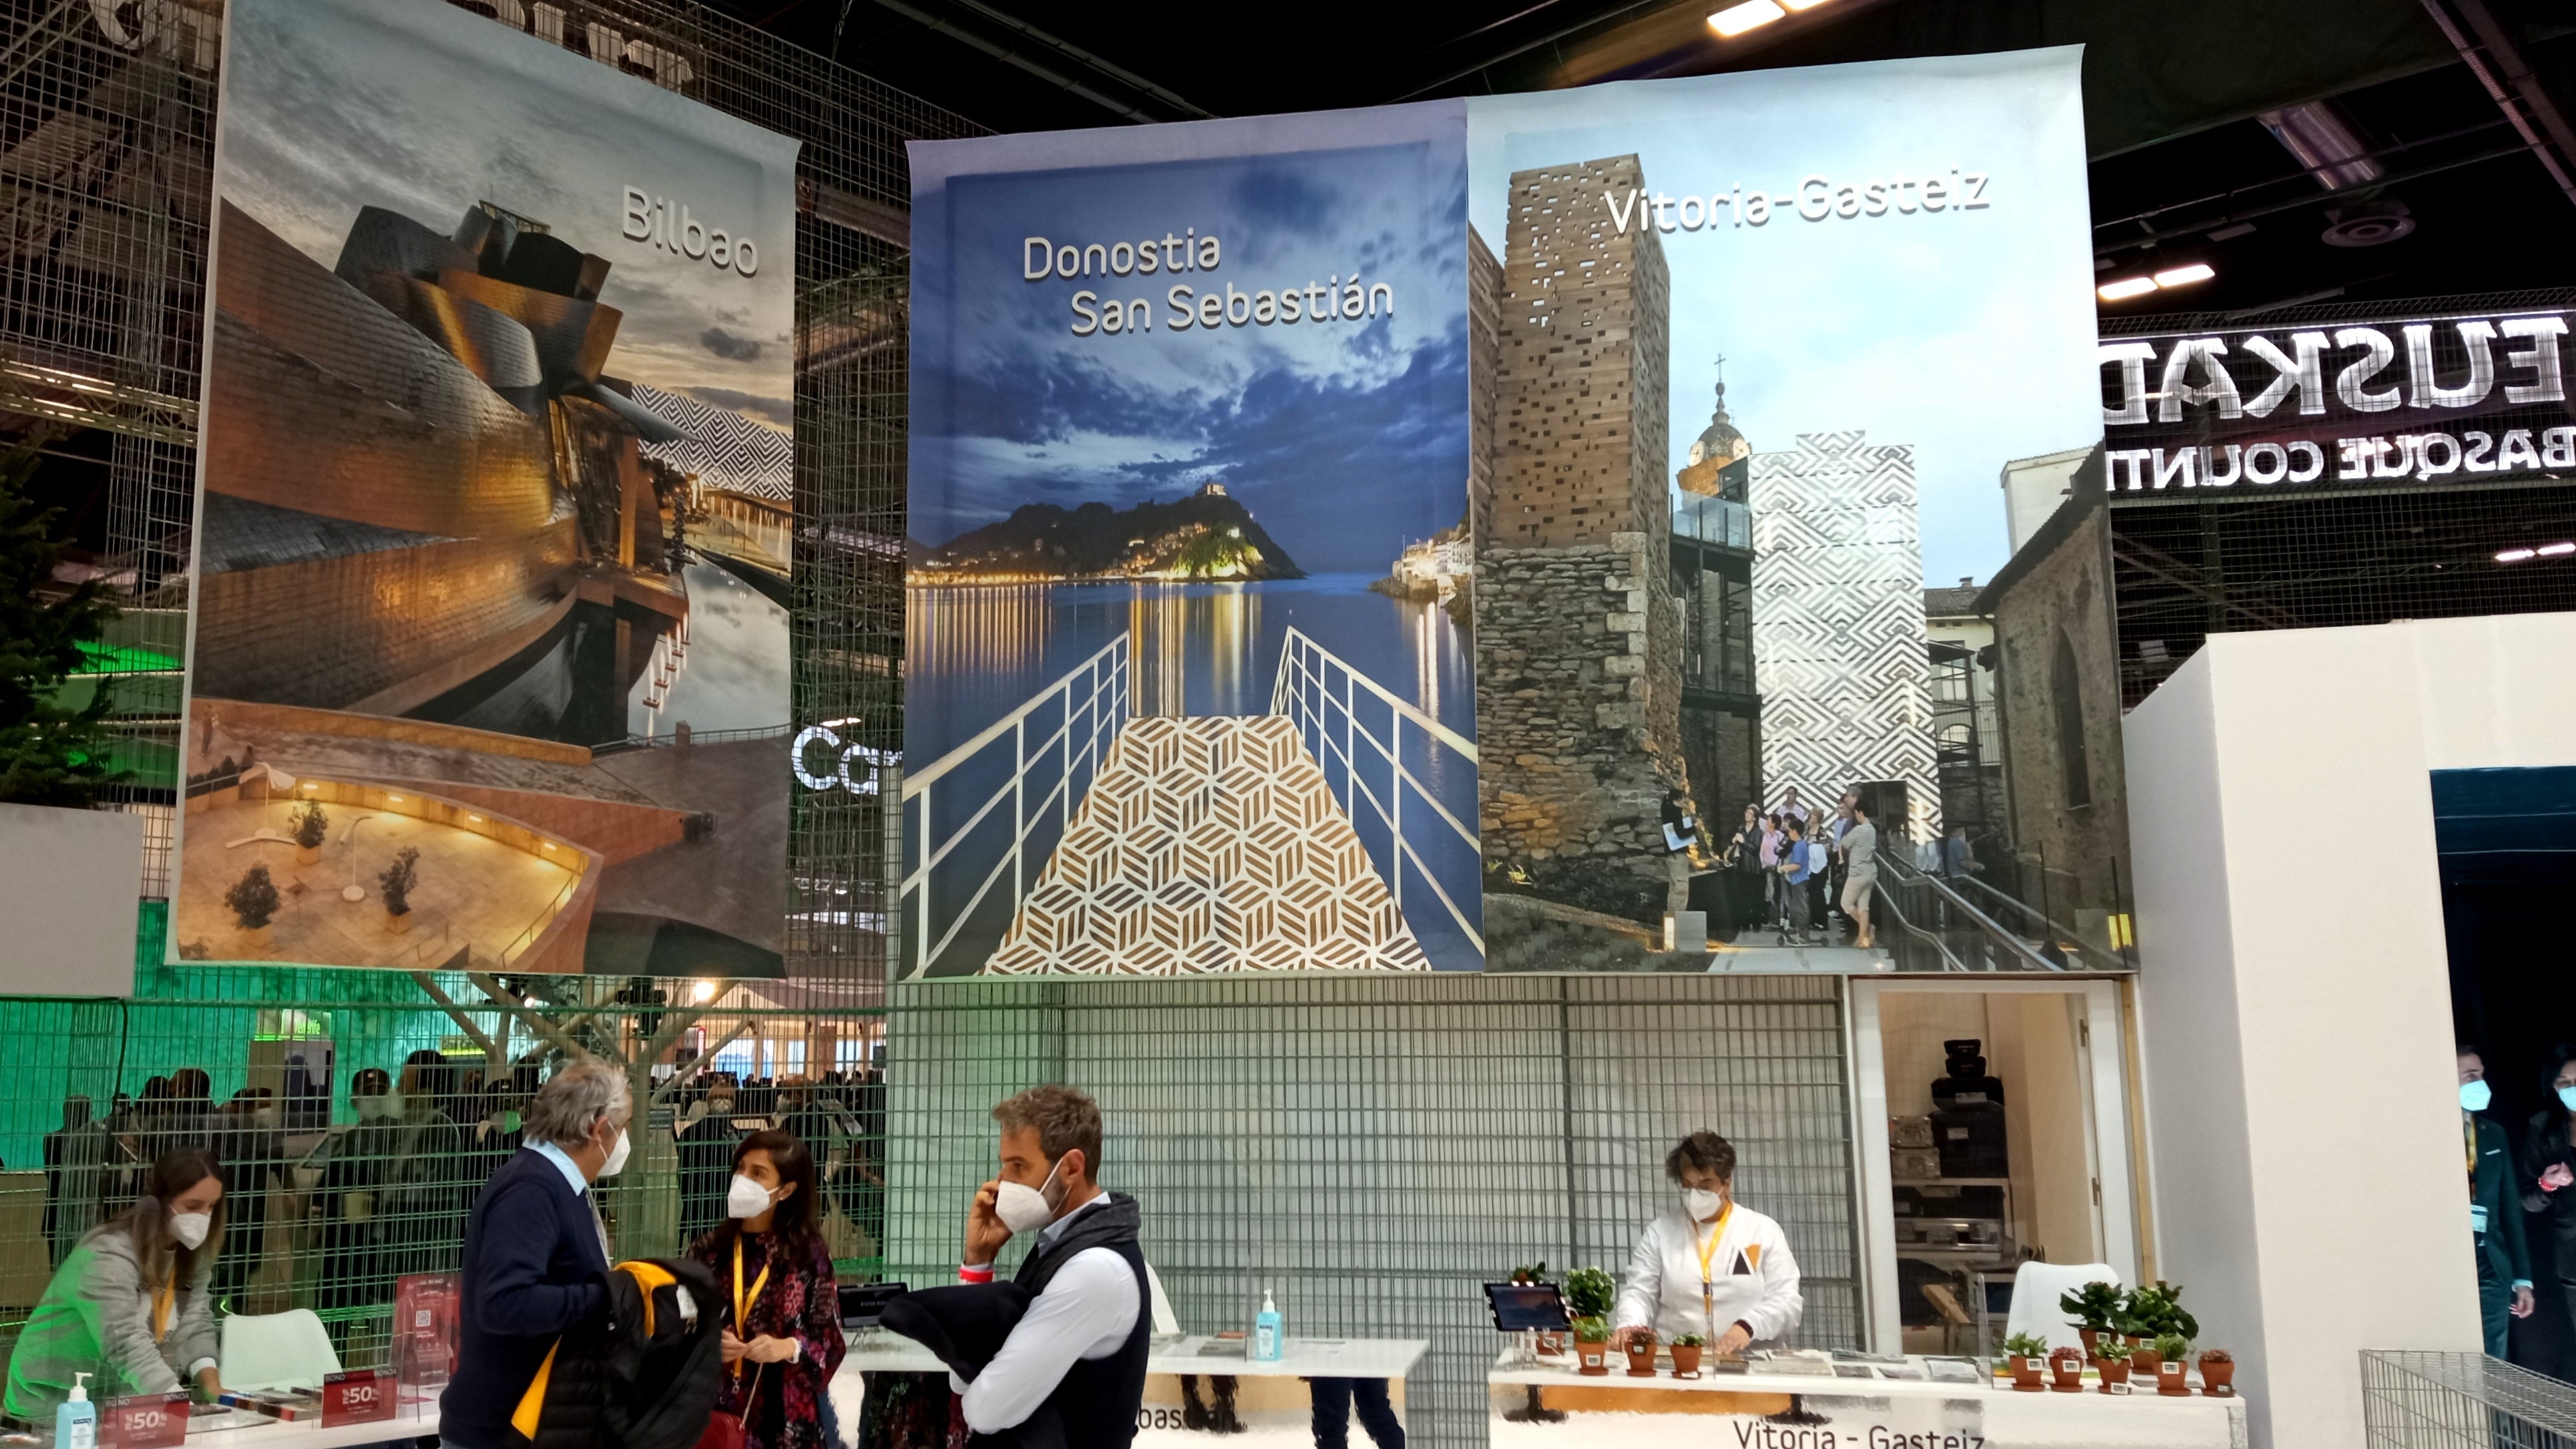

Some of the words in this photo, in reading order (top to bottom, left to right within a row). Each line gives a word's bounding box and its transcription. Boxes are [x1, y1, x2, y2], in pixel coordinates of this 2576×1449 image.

[1604, 164, 1990, 234] Vitoria-Gasteiz
[623, 184, 757, 278] Bilbao
[1024, 226, 1220, 281] Donostia
[1071, 290, 1152, 335] San
[1168, 273, 1393, 329] Sebastián
[105, 1398, 130, 1407] BONO
[325, 1374, 345, 1382] BONO
[1733, 1420, 1836, 1449] Vitoria
[1869, 1425, 1985, 1449] Gasteiz
